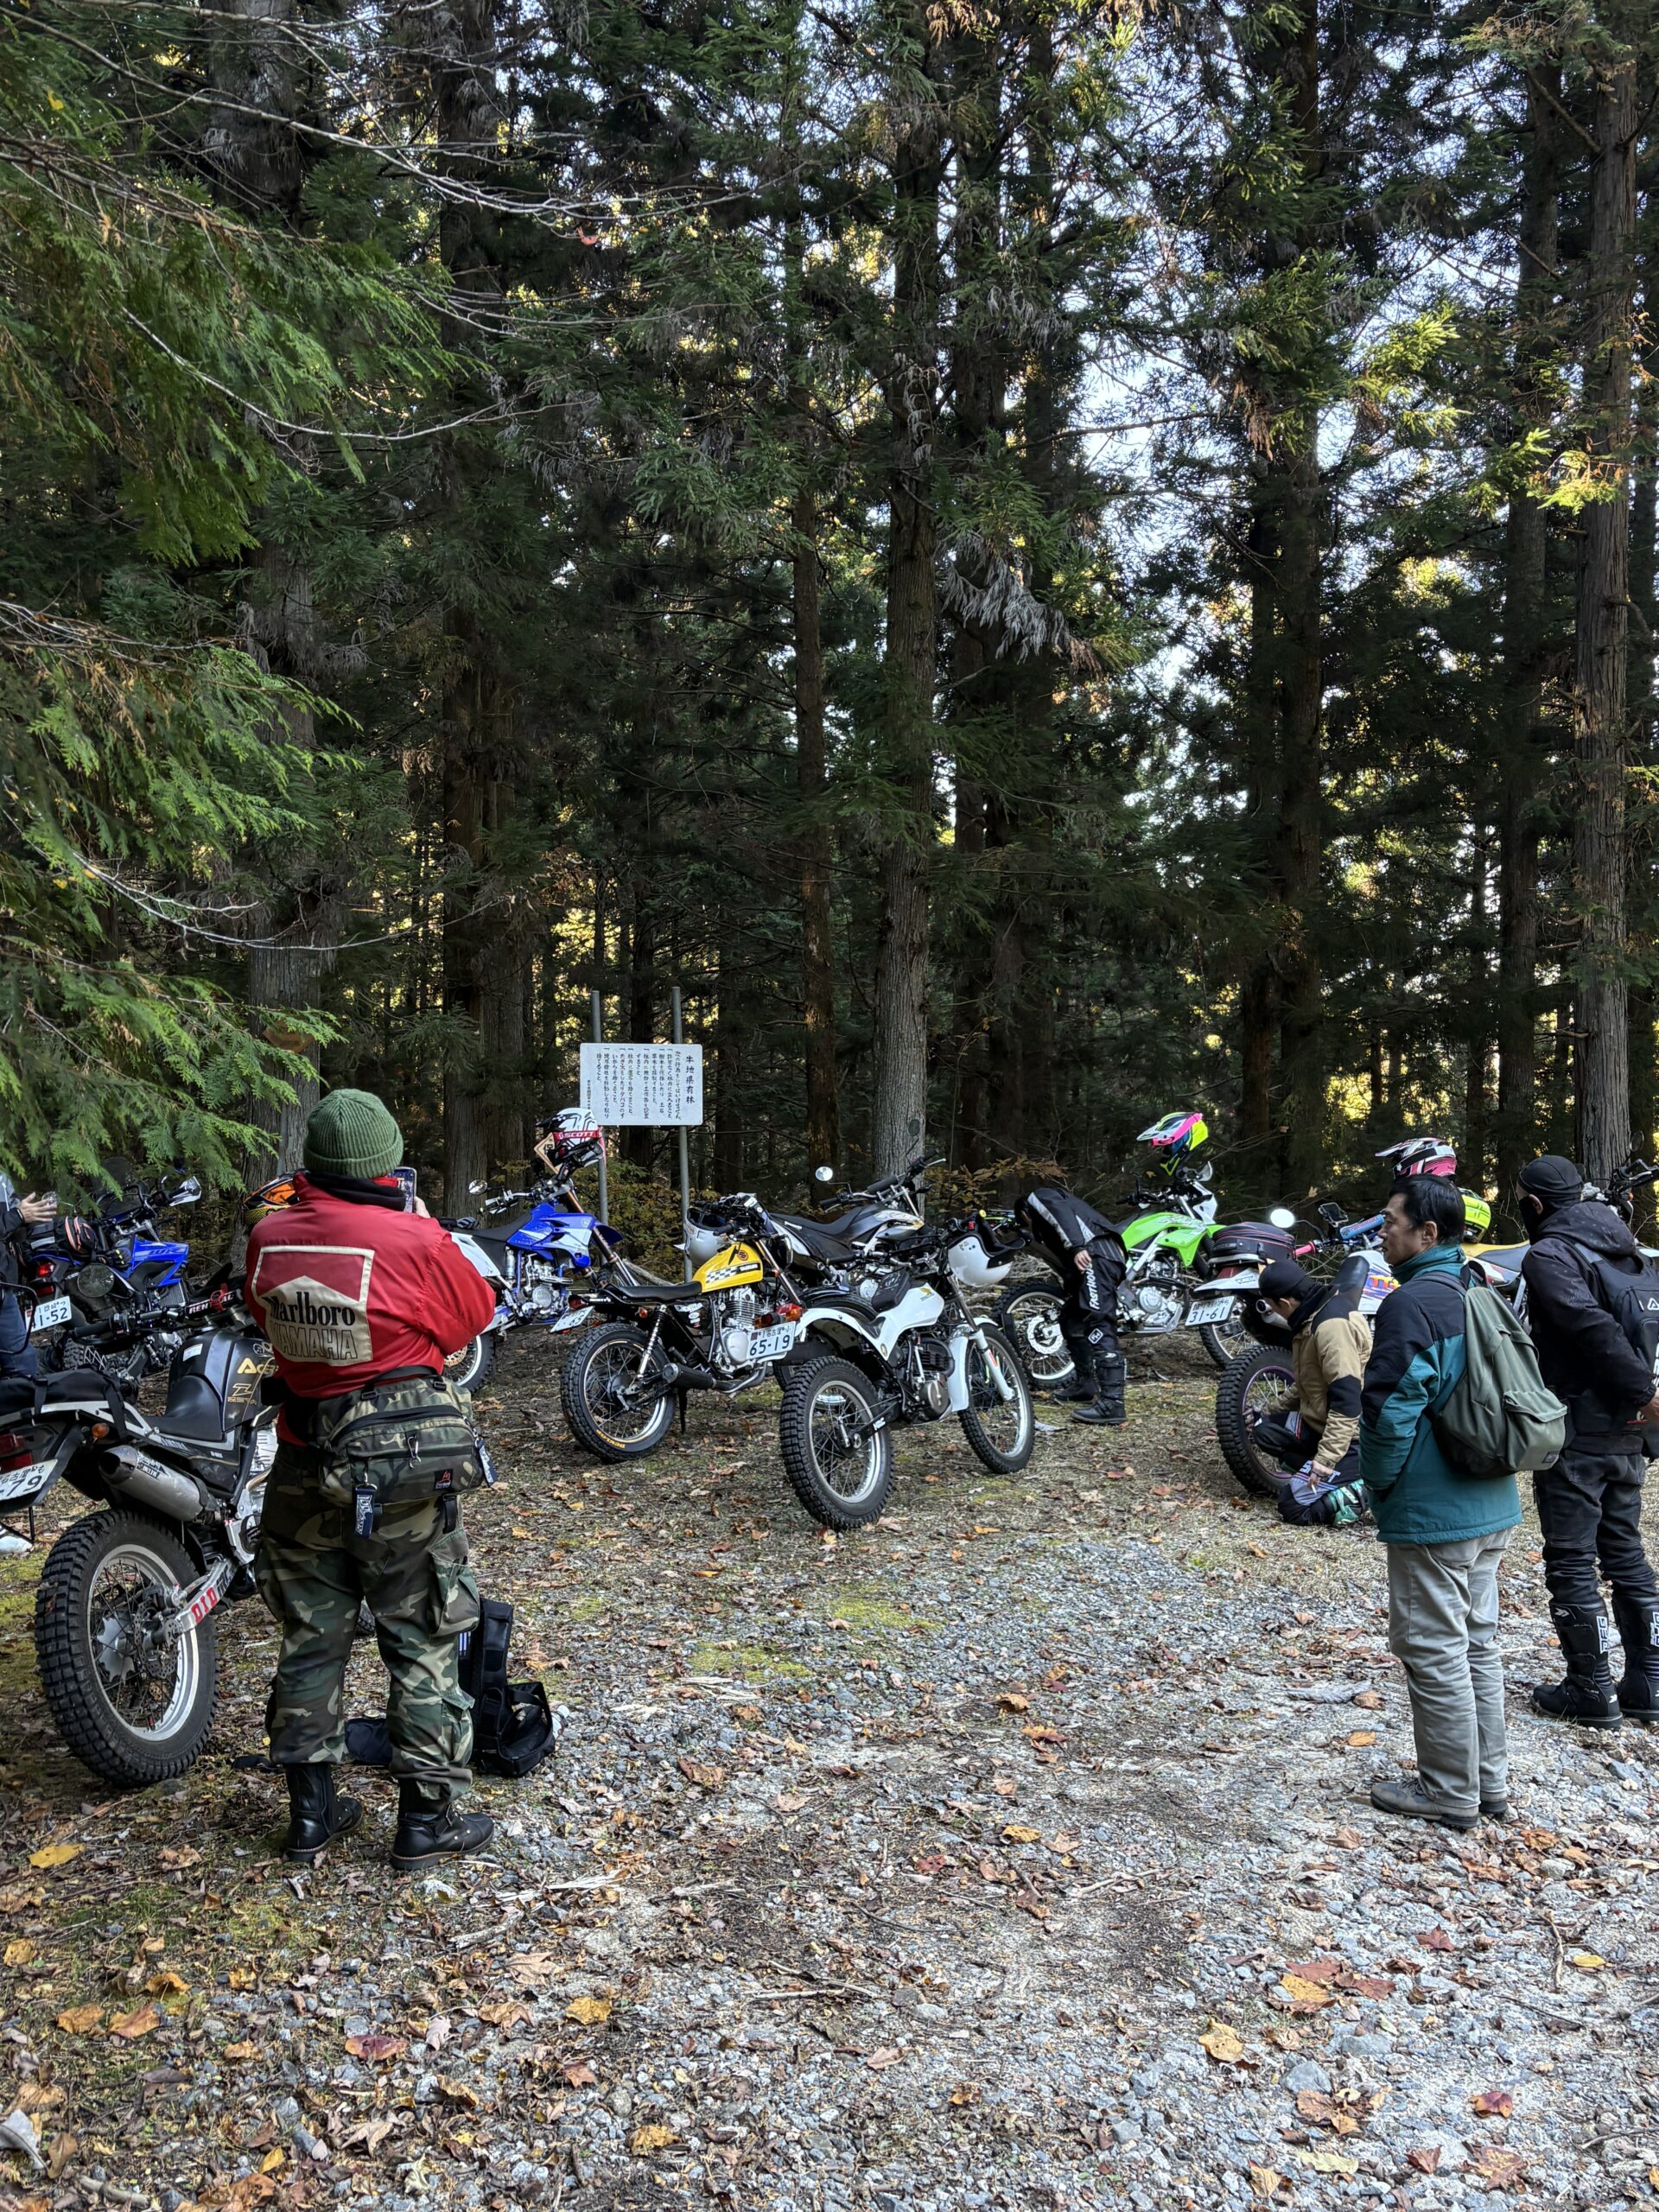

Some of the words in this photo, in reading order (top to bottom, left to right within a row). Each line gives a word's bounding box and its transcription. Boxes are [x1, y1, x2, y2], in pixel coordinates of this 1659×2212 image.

[686, 1054, 696, 1104] 牛地県有林
[262, 1291, 356, 1326] Marlboro
[269, 1320, 359, 1360] YAMAHA
[189, 1586, 219, 1624] DID
